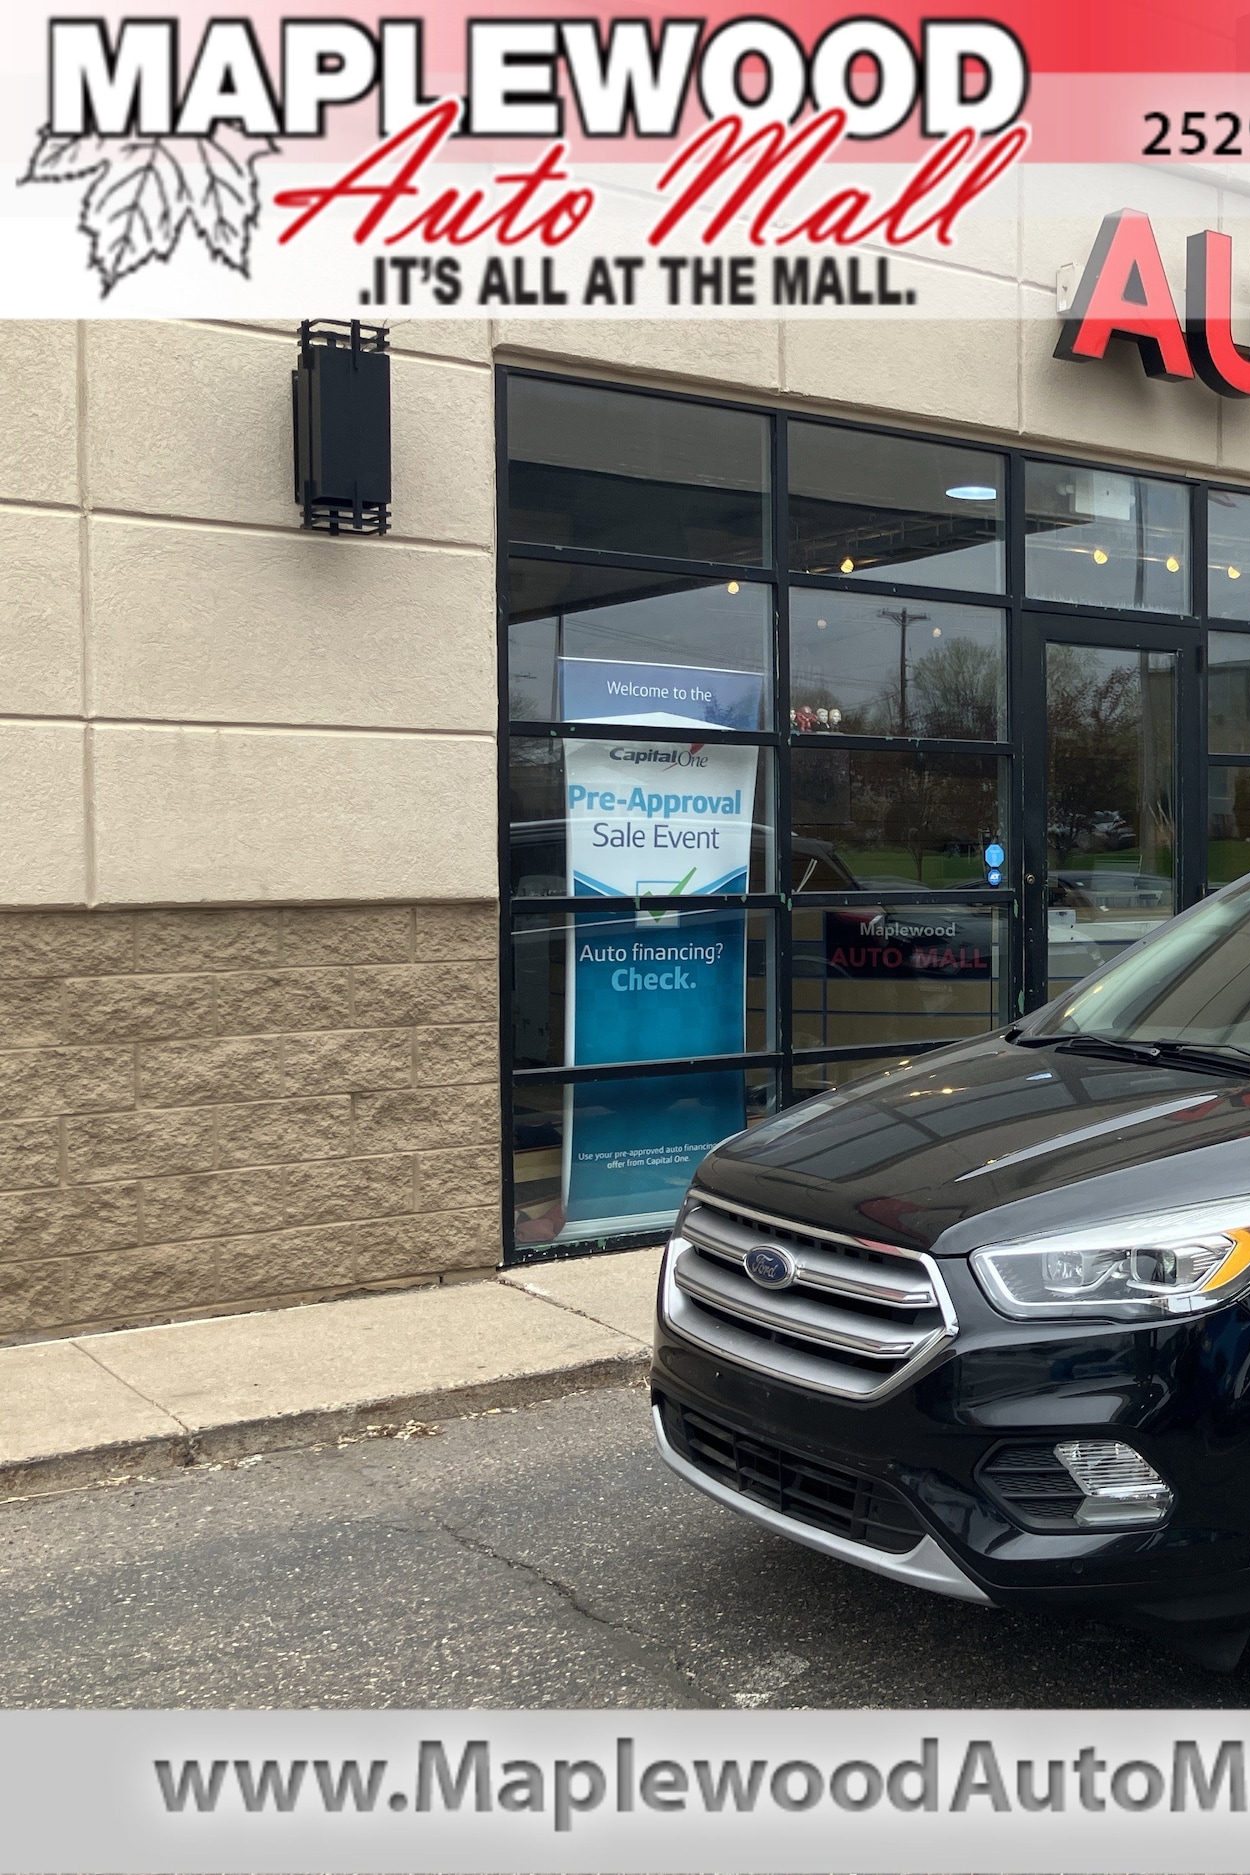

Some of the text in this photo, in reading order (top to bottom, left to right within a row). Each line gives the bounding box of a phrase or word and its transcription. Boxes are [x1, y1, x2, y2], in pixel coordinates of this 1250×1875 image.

[607, 680, 712, 702] Welcome to the
[609, 747, 677, 765] Capital
[568, 784, 741, 819] Pre-Approval
[592, 822, 720, 849] Sale Event
[860, 922, 956, 940] Maplewood
[579, 942, 724, 965] Auto financing?
[830, 947, 987, 968] AUTO MALL
[611, 966, 697, 991] Check.
[578, 1152, 594, 1161] Use
[595, 1152, 612, 1161] your
[614, 1145, 664, 1160] pre-approved
[665, 1144, 683, 1154] auto
[607, 1160, 625, 1169] offer
[627, 1158, 645, 1167] from
[646, 1155, 673, 1166] Capital
[752, 1253, 779, 1278] Ford
